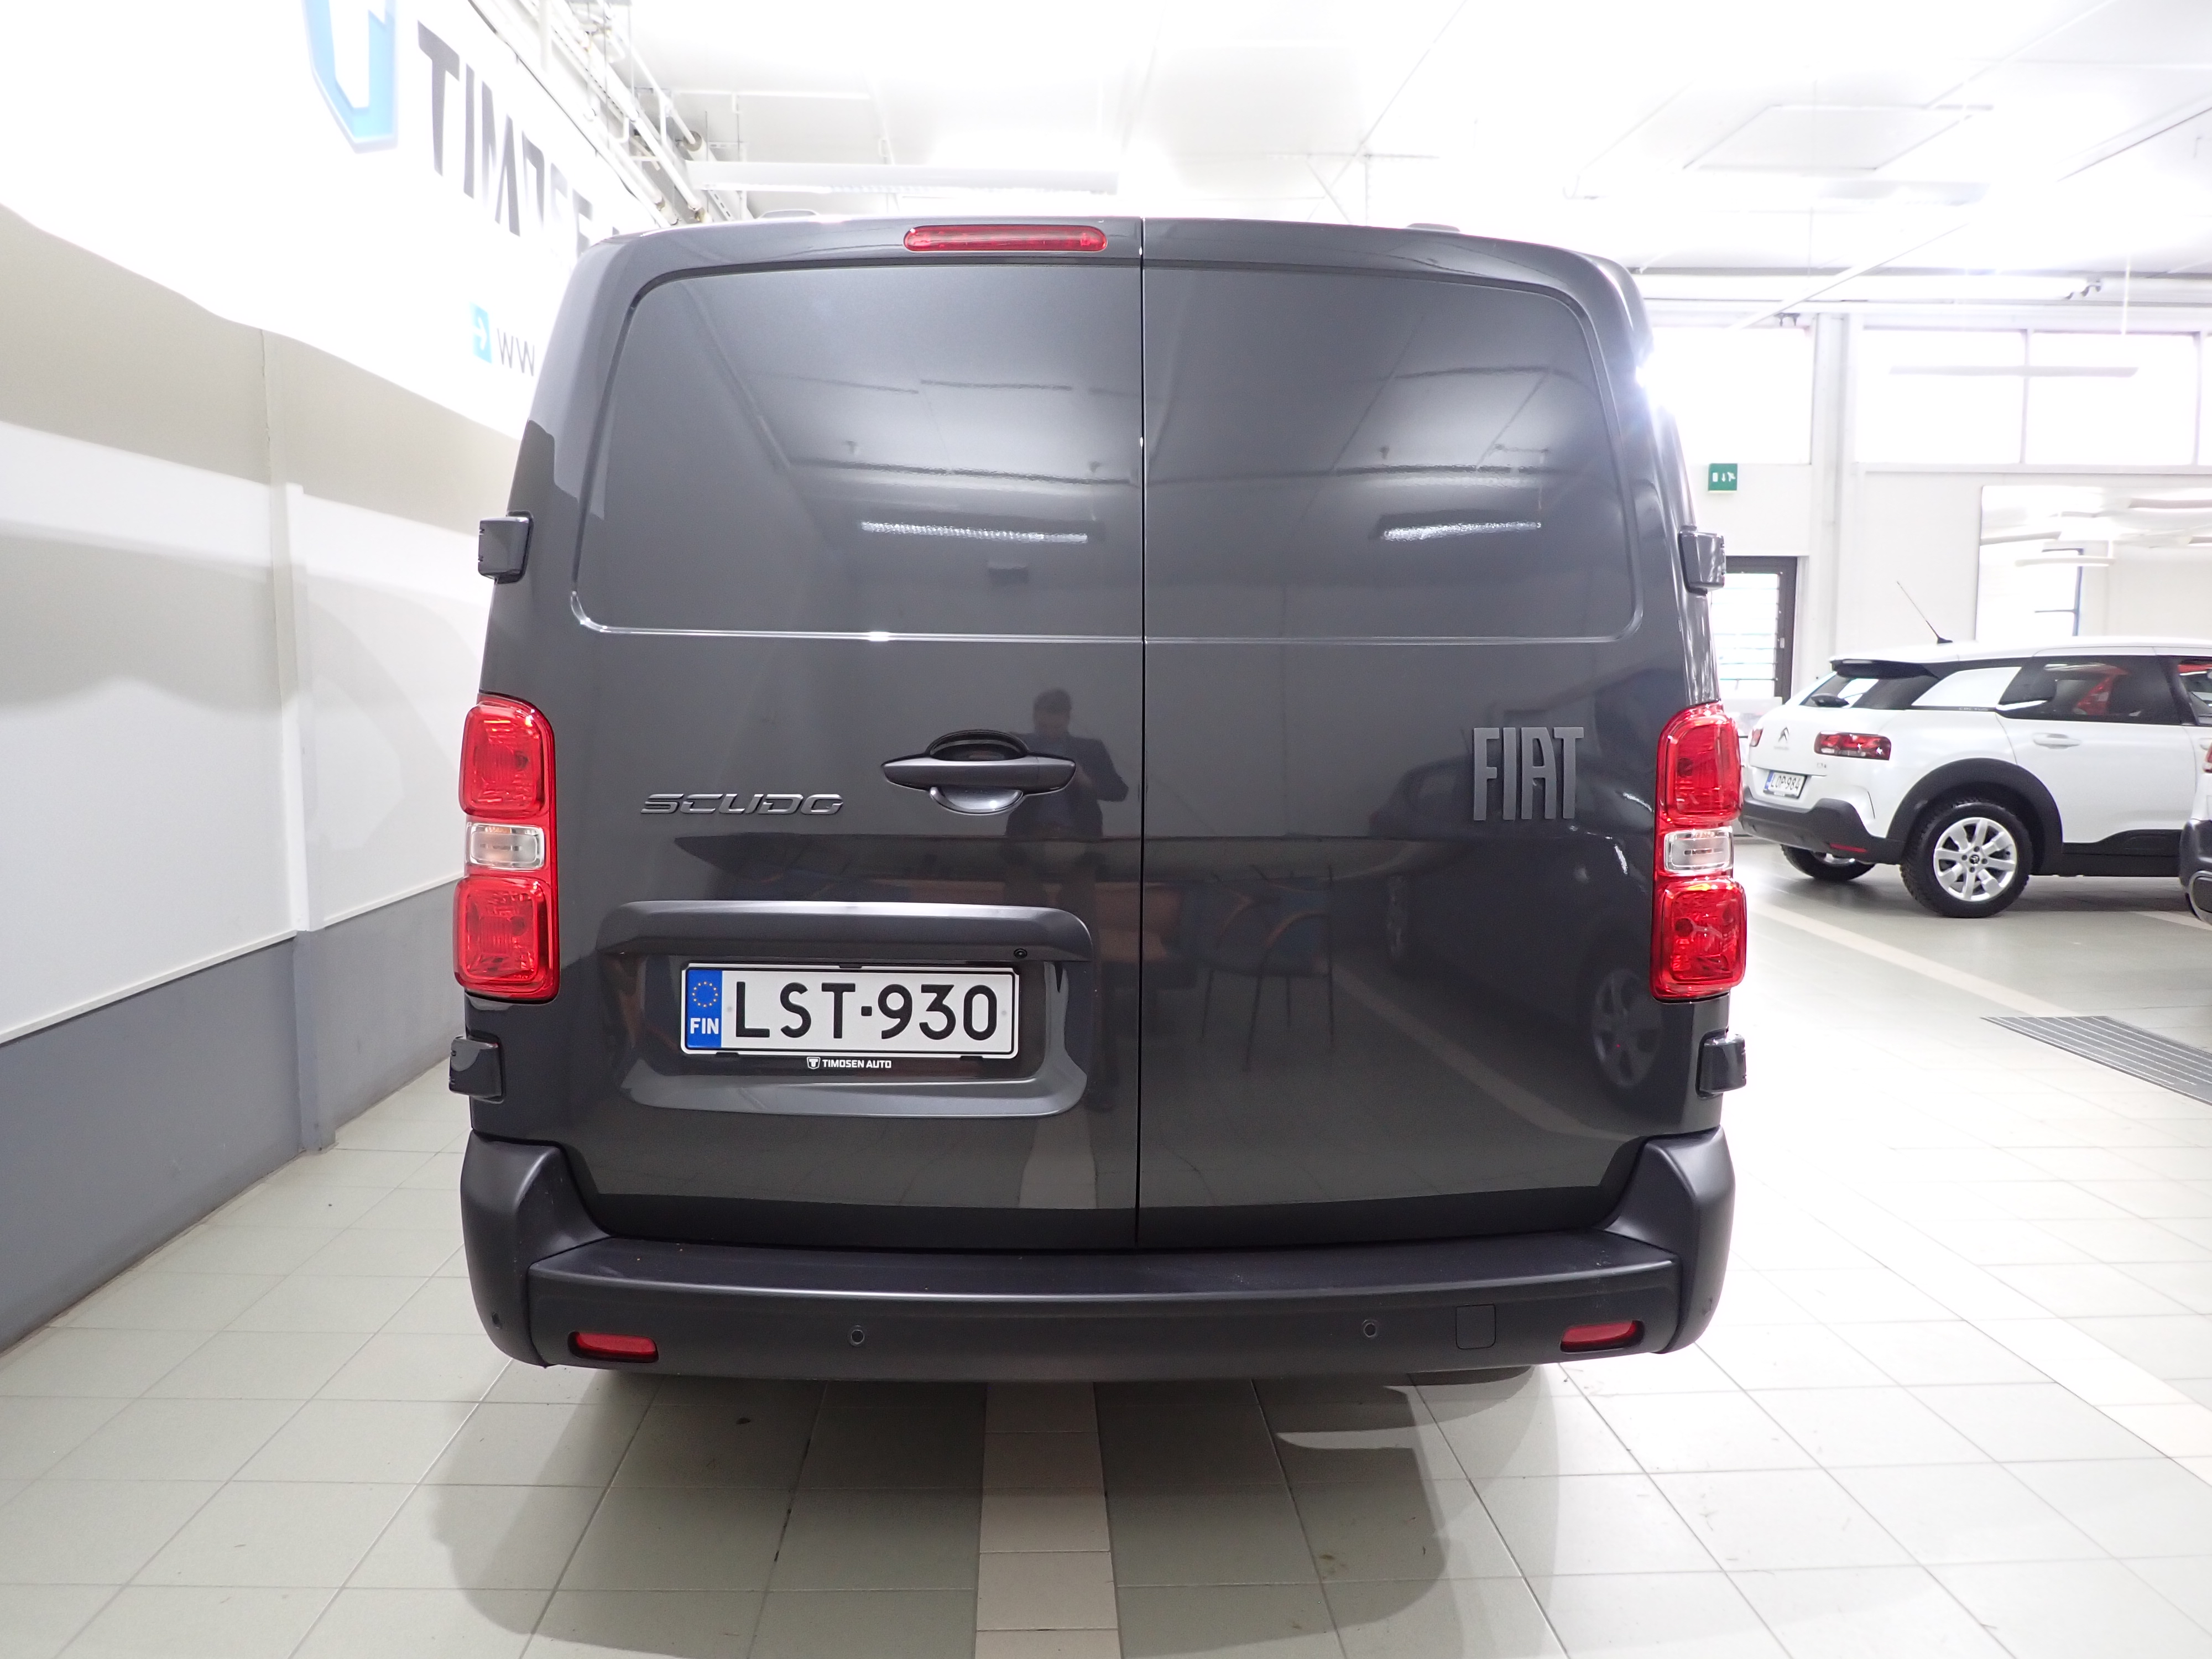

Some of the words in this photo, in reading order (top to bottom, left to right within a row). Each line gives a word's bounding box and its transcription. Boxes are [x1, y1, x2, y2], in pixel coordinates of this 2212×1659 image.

[1473, 726, 1584, 821] FIAT
[640, 793, 844, 815] SCUDO
[690, 1018, 719, 1035] FIN
[822, 1059, 864, 1068] TIMOSEN
[865, 1060, 892, 1068] AUTO
